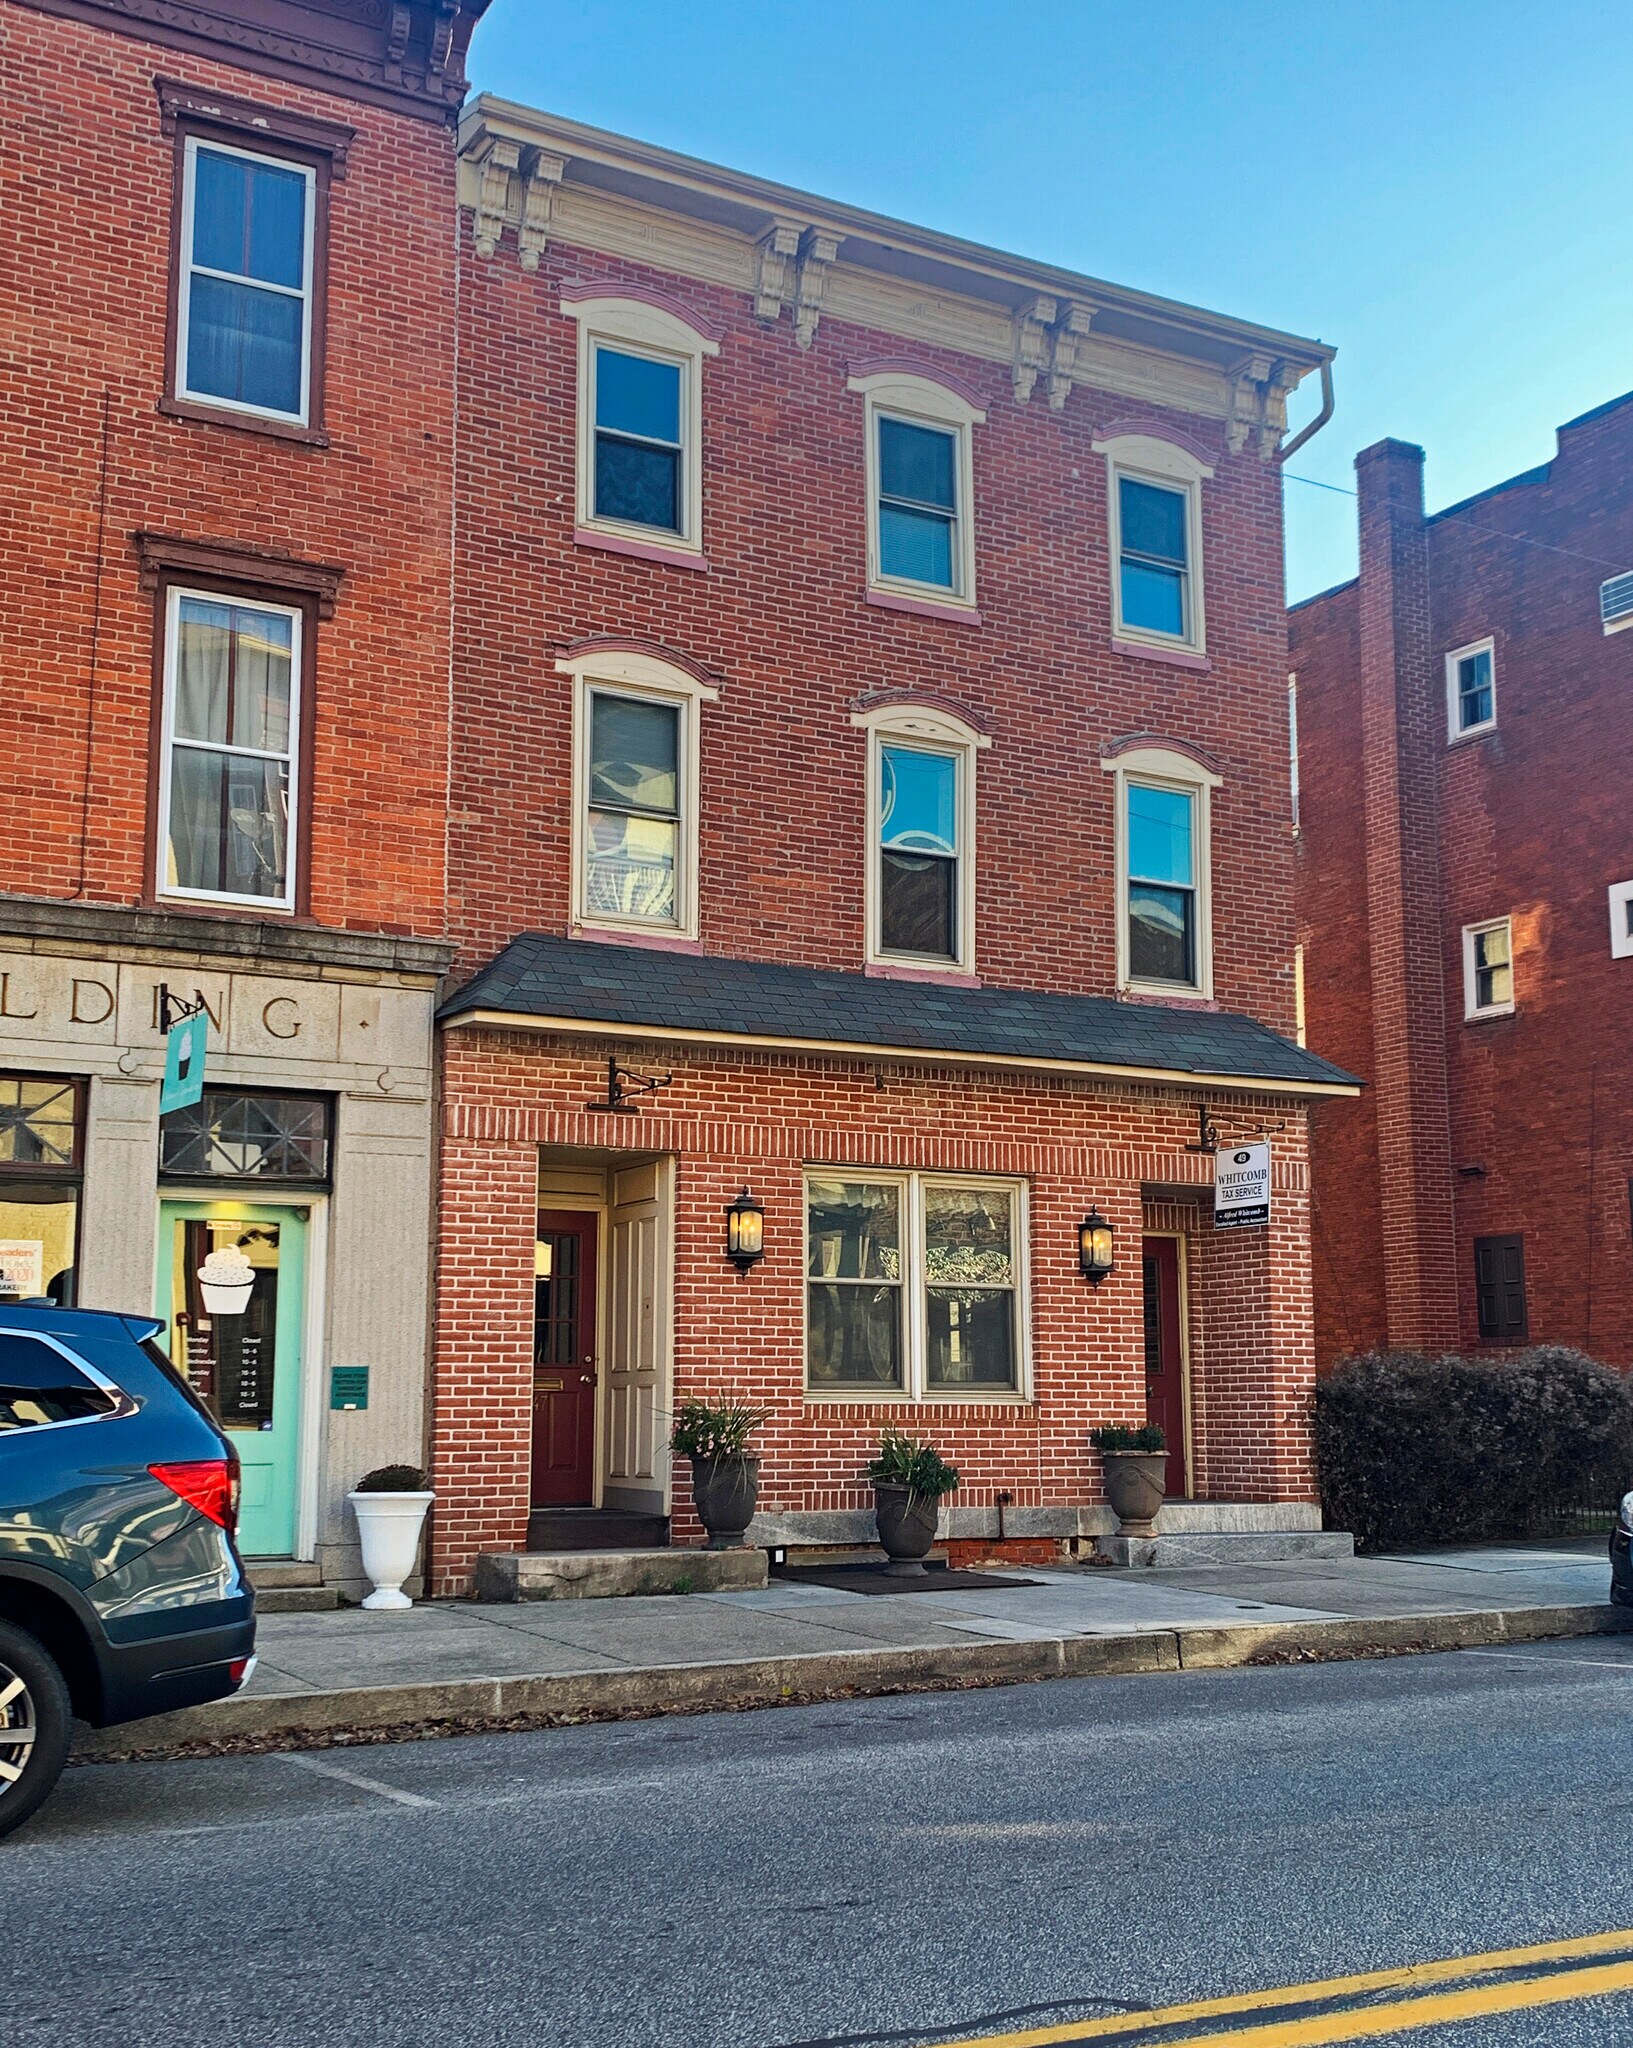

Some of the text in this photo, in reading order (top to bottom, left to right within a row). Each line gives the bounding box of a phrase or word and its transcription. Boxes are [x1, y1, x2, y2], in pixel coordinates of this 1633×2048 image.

[1237, 1153, 1247, 1162] 49
[1218, 1168, 1267, 1185] WHITCOMB
[1221, 1185, 1262, 1199] TAX SERVICE
